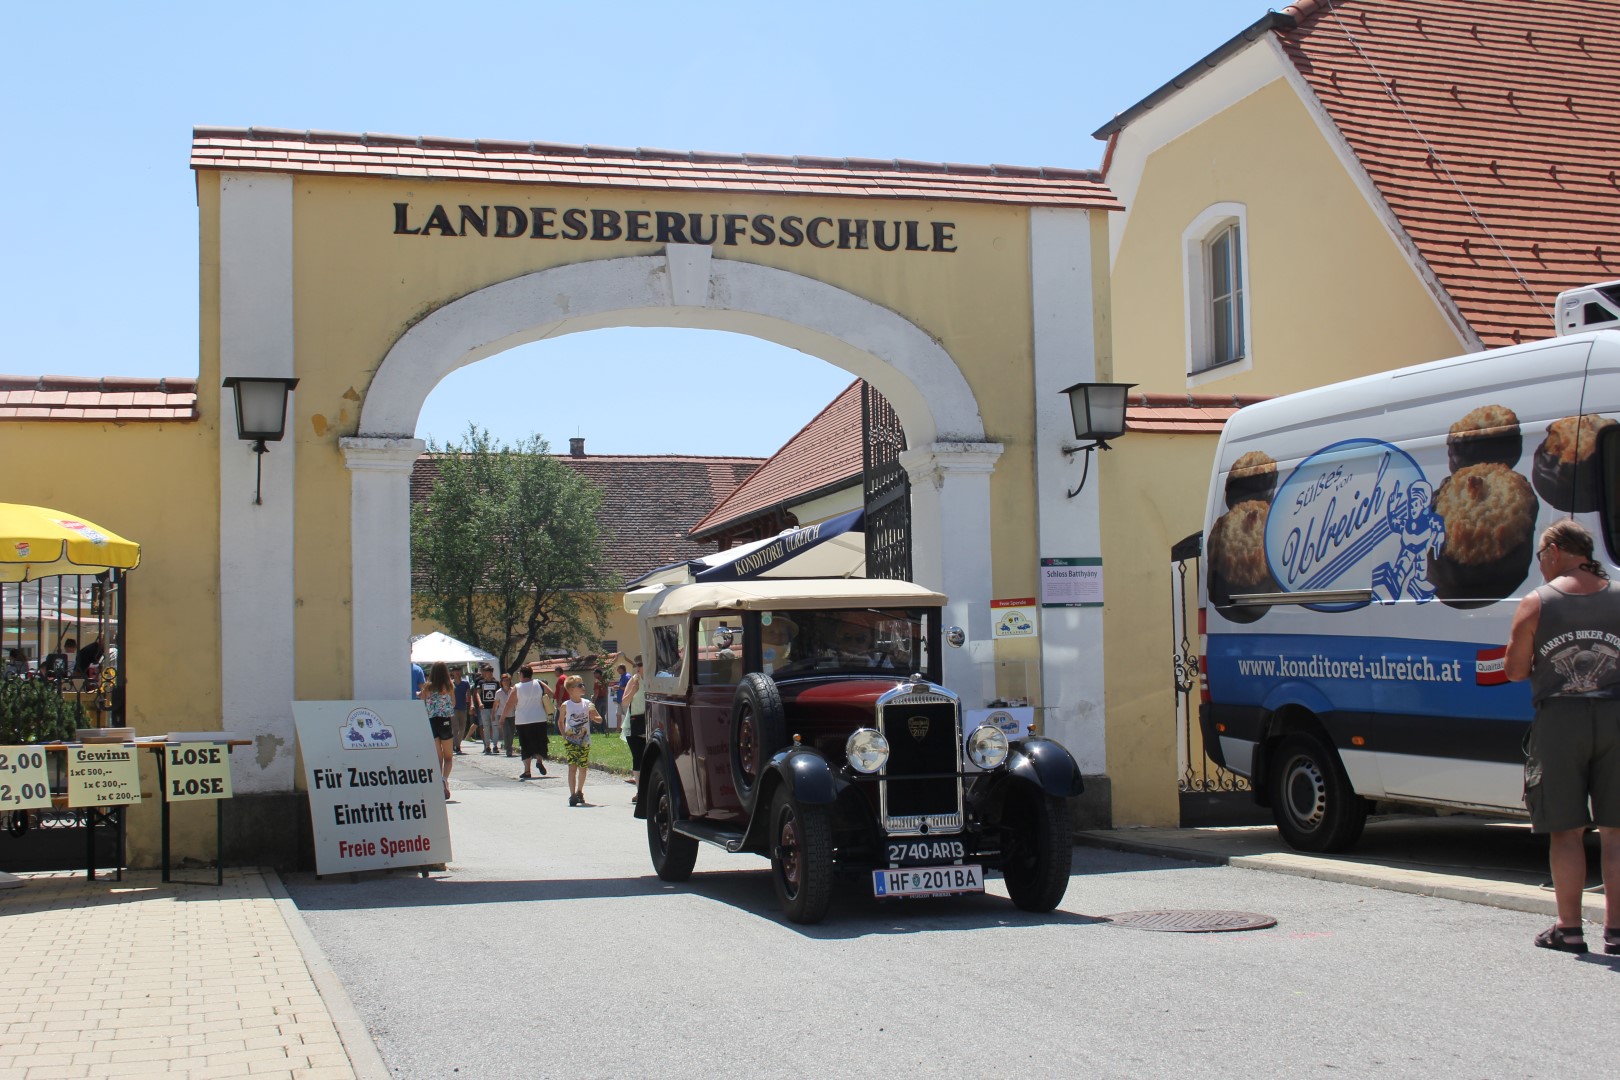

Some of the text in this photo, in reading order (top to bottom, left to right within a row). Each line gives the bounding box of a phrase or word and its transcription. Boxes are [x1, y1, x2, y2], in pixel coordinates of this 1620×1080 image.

[393, 202, 957, 253] LANDESBERUFSSCHULE
[1282, 451, 1391, 584] Ulreich
[735, 524, 820, 576] KONDITOREI ULREICH
[1047, 570, 1067, 578] Schloss
[1539, 631, 1574, 657] HARRY'S
[1576, 630, 1603, 640] BIKER
[1238, 655, 1462, 682] www.konditorei-ulreich.at
[0, 753, 43, 774] 2,00
[76, 750, 131, 761] Gewinn
[171, 749, 222, 766] LOSE
[173, 778, 224, 796] LOSE
[313, 766, 434, 789] Für Zuschauer
[0, 783, 47, 805] 2,00
[334, 799, 427, 826] Eintritt frei
[338, 834, 431, 859] Freie Spende
[889, 873, 910, 891] HF
